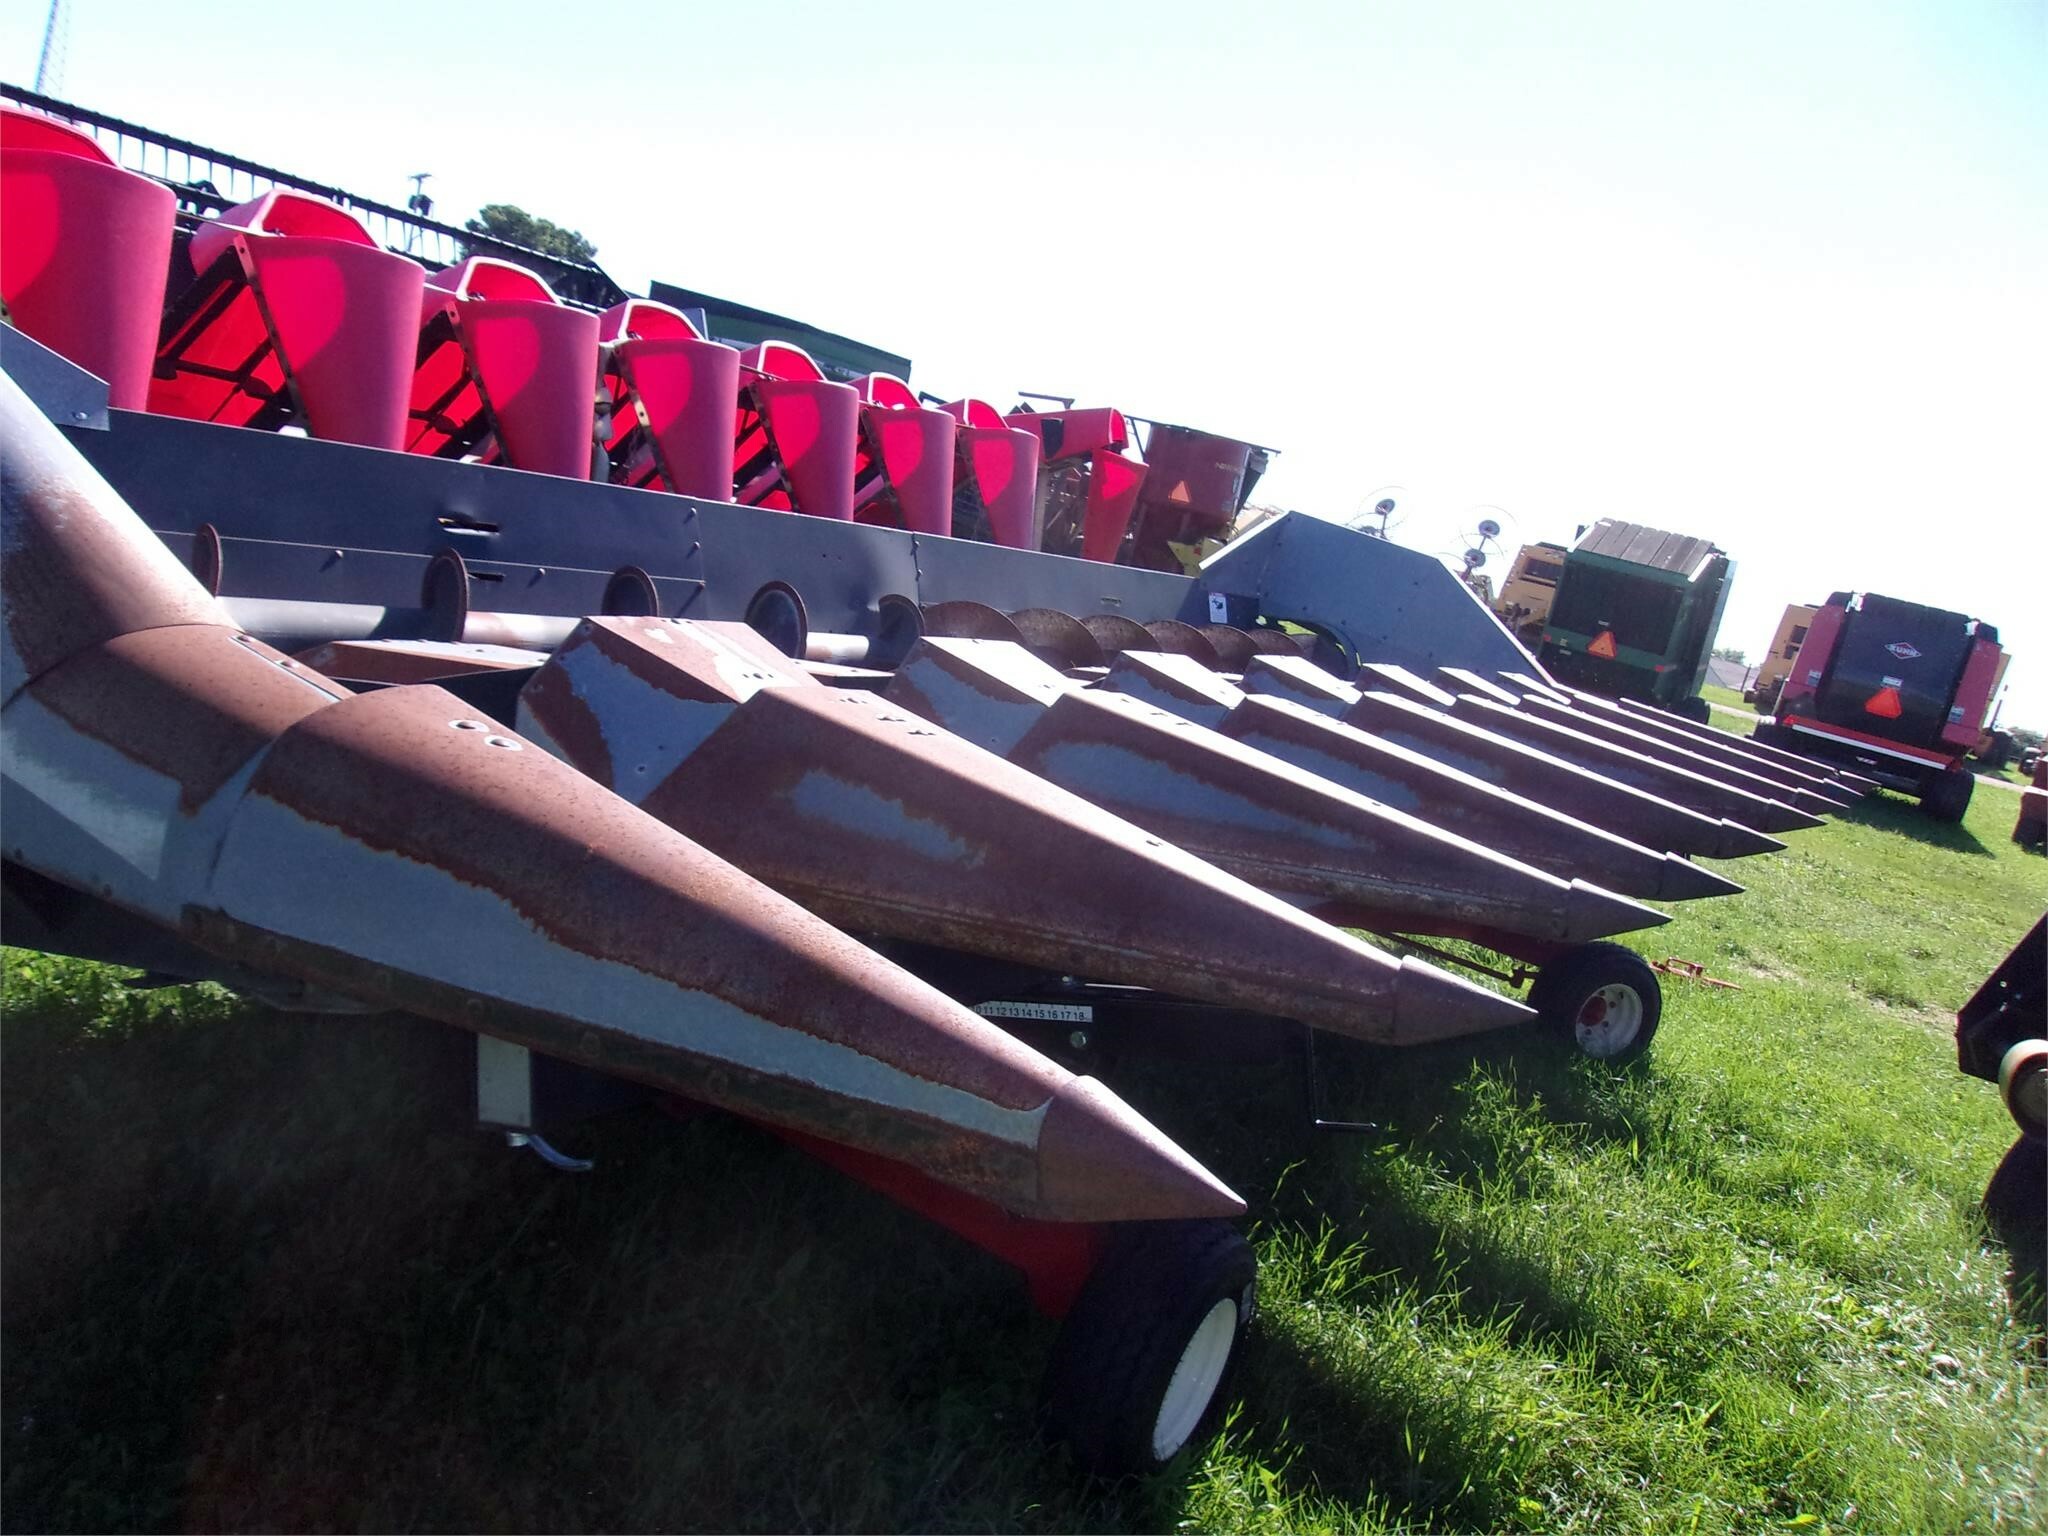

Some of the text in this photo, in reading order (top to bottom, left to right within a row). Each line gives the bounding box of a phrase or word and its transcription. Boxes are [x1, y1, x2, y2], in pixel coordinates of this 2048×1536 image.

[1889, 644, 1917, 657] KUHN
[984, 1006, 993, 1015] 11
[996, 1006, 1006, 1015] 12
[1009, 1007, 1020, 1016] 13
[1021, 1008, 1032, 1017] 14
[1034, 1009, 1045, 1018] 15
[1047, 1010, 1058, 1019] 16
[1060, 1011, 1071, 1020] 17
[1073, 1011, 1084, 1020] 18
